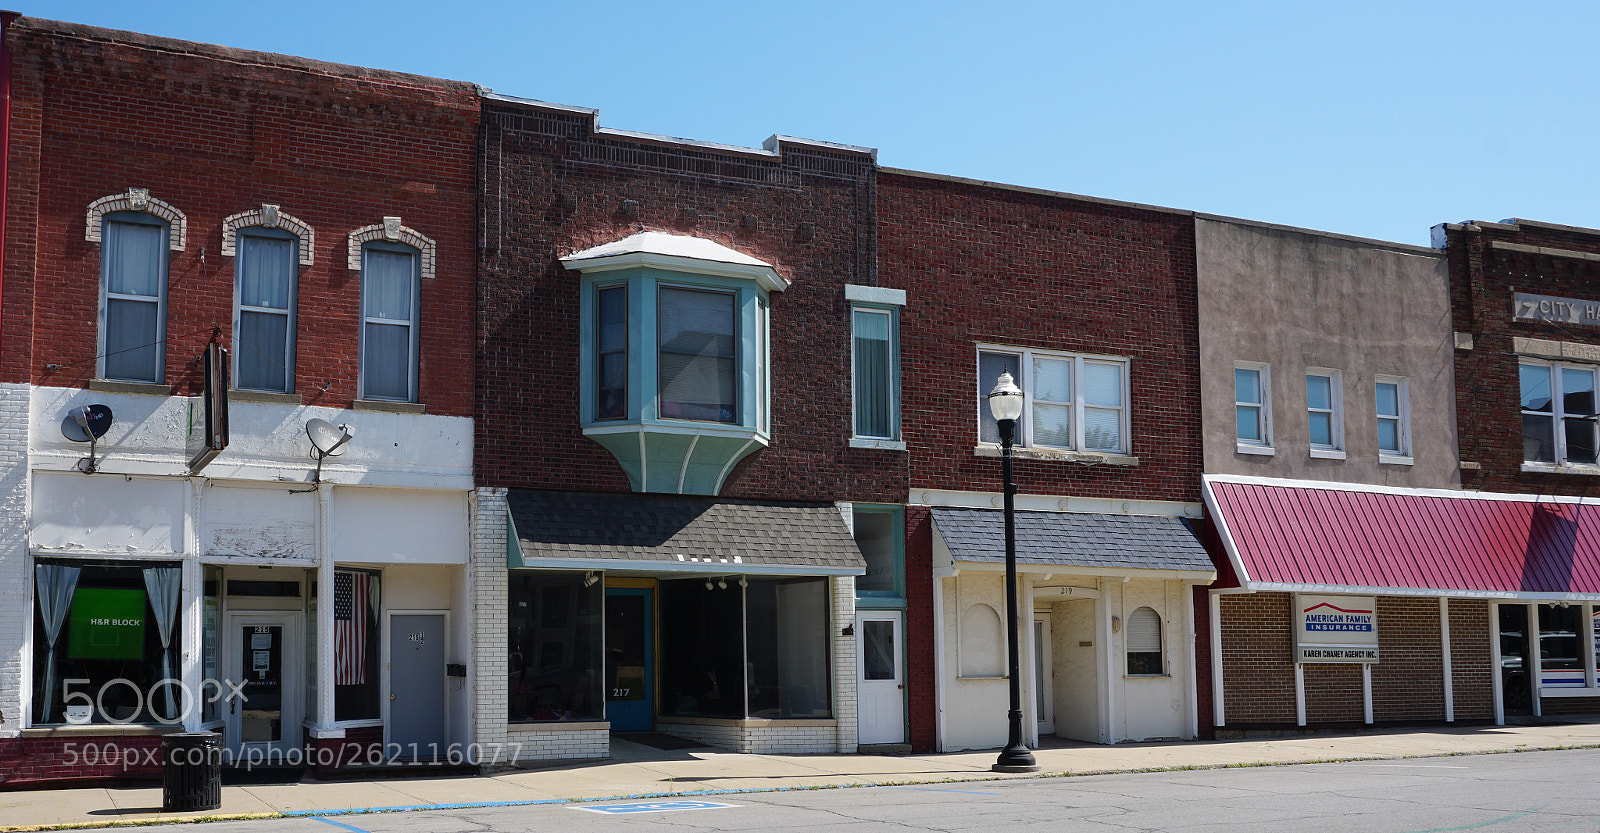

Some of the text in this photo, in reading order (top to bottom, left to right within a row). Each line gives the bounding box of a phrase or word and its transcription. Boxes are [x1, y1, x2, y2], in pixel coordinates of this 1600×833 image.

[1540, 300, 1575, 318] CITY
[1060, 587, 1073, 595] 219
[90, 618, 141, 627] H&R BLOCK
[1305, 614, 1372, 624] AMERICAN FAMILY
[1303, 649, 1377, 659] KAREN CHANEY AGENCY INC.
[612, 687, 630, 697] 217
